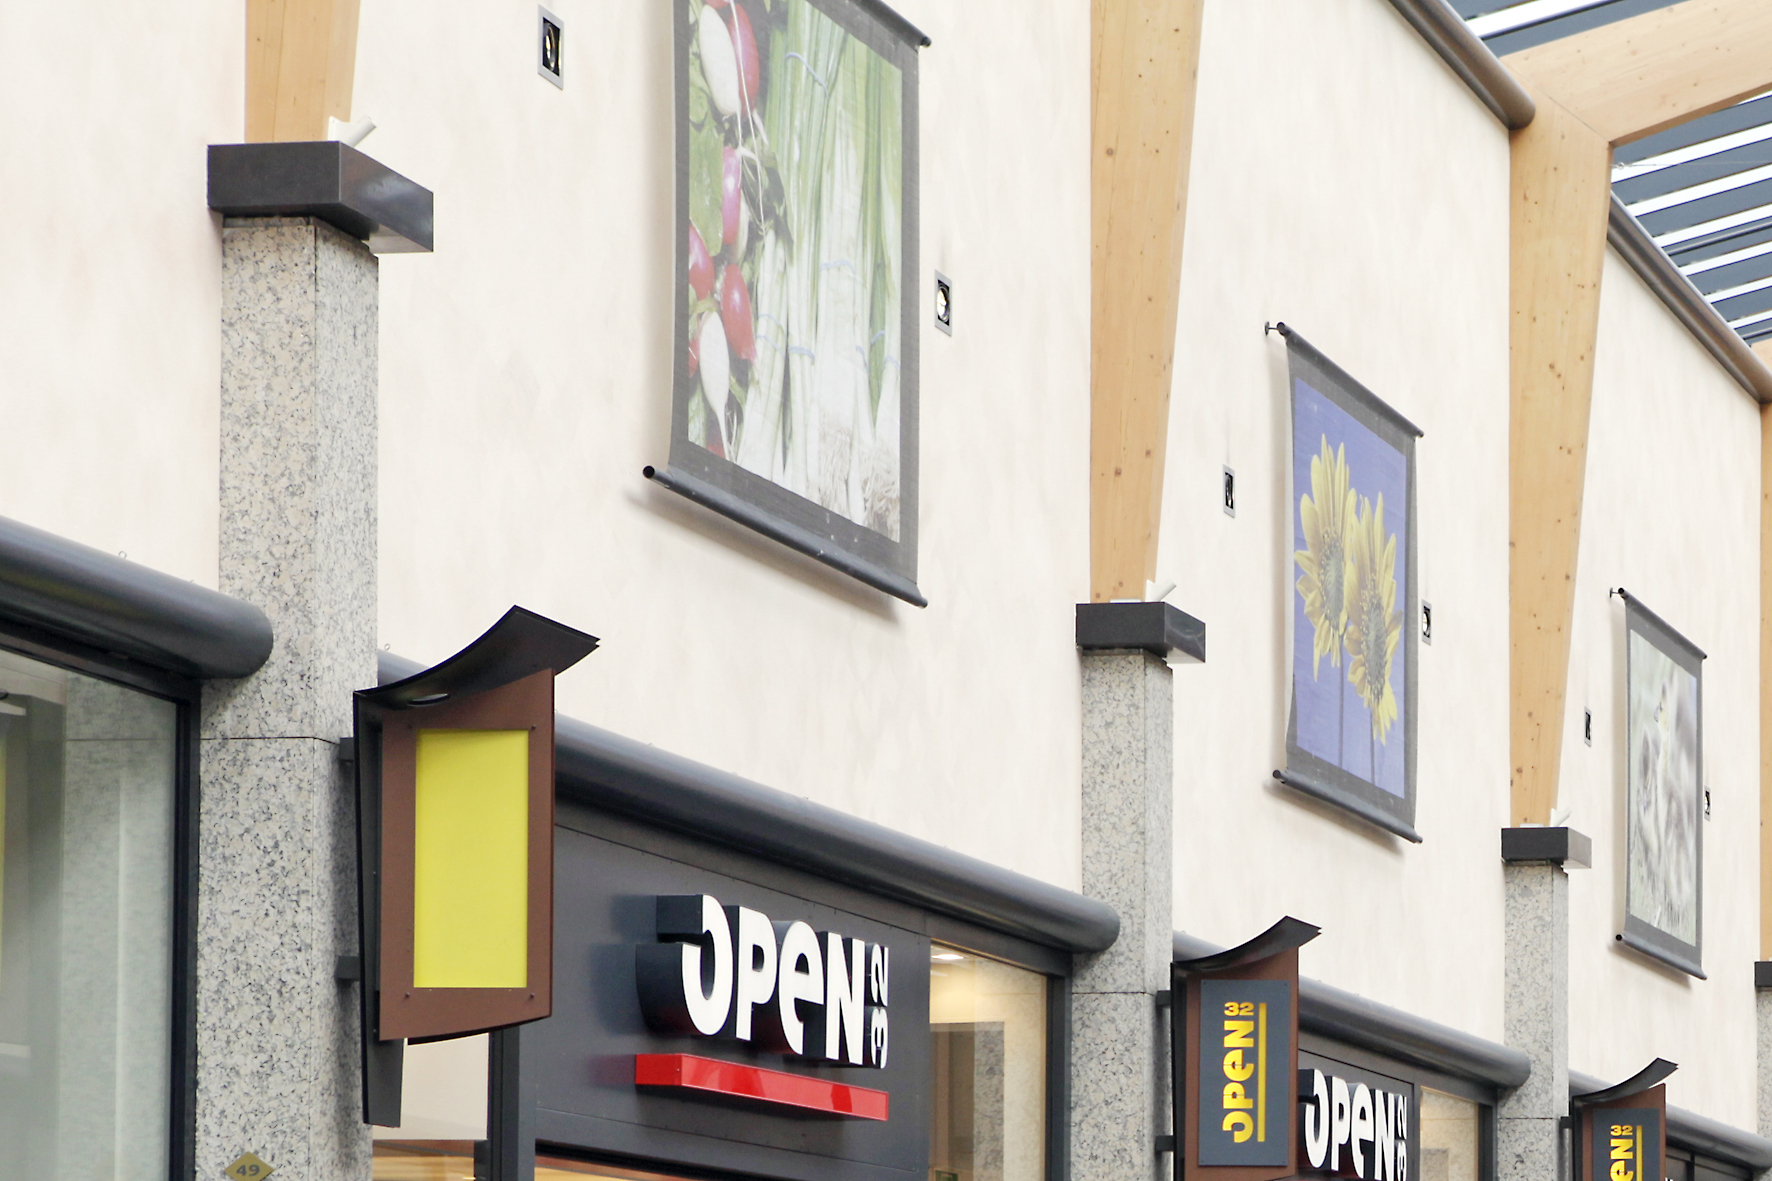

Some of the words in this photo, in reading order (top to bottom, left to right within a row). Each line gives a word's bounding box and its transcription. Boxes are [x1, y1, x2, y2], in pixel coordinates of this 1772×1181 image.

[870, 943, 889, 1069] 32
[1224, 1001, 1254, 1016] 32
[1610, 1124, 1633, 1136] 32
[236, 1164, 260, 1176] 49
